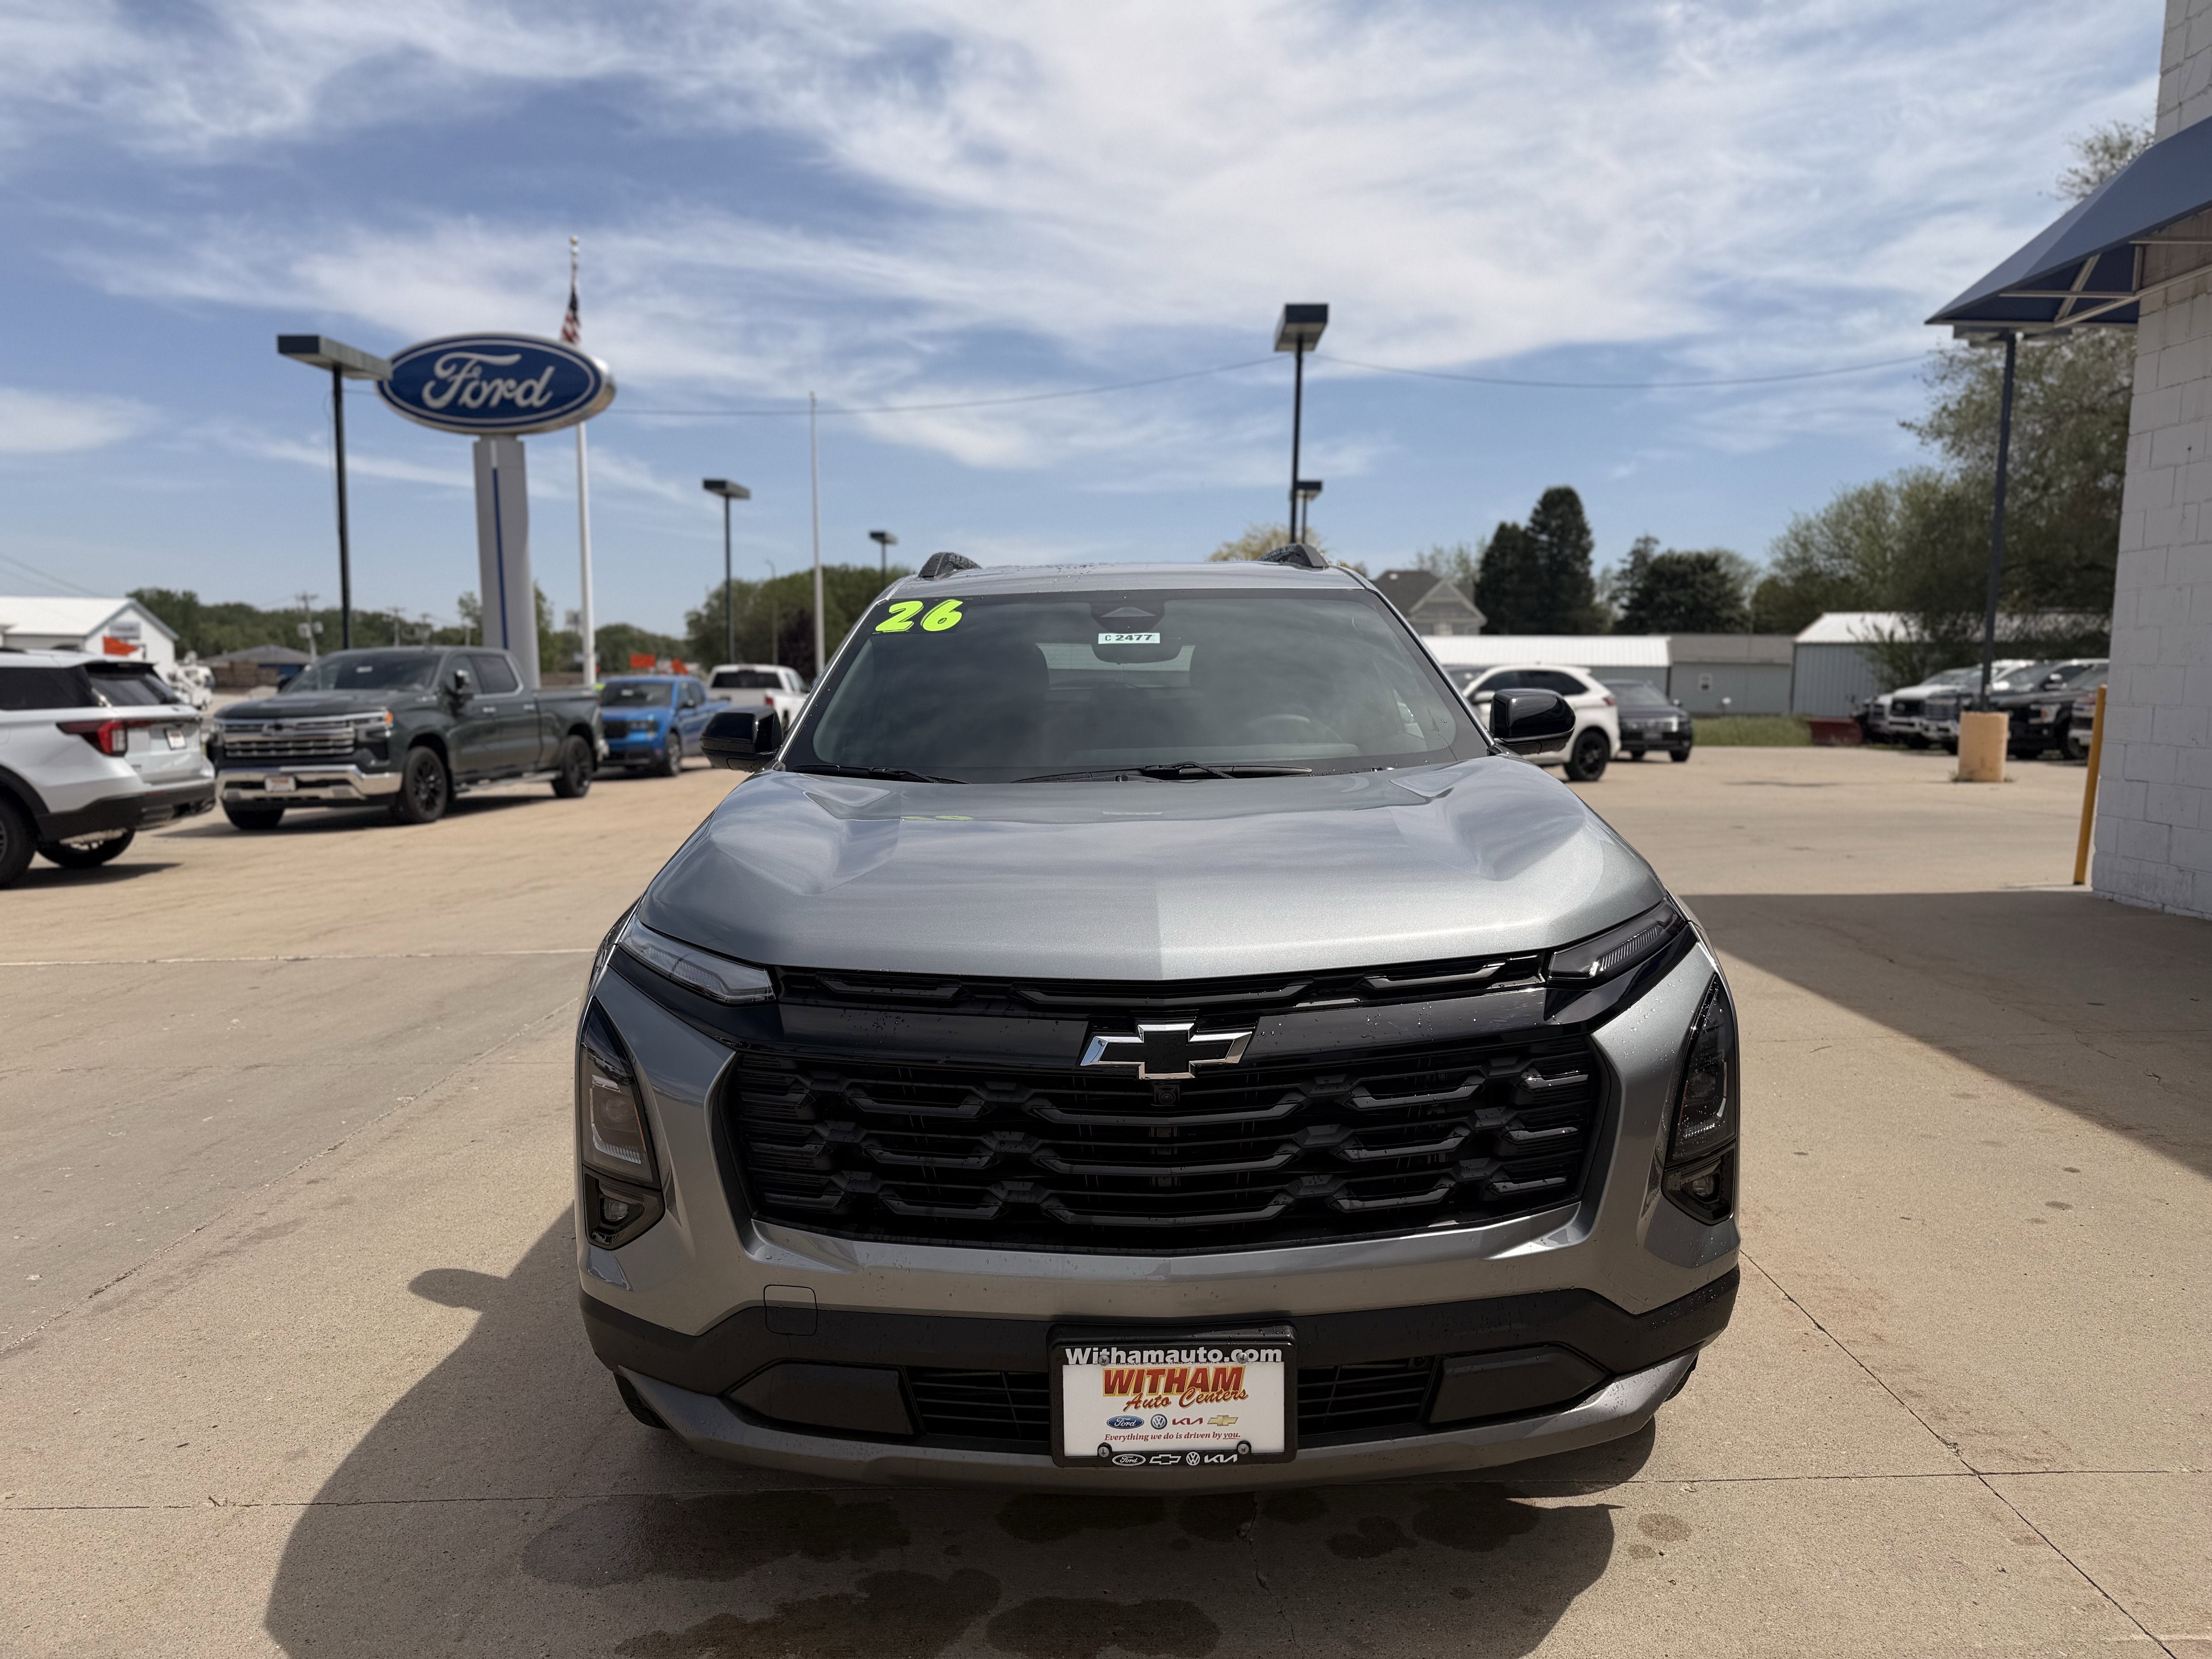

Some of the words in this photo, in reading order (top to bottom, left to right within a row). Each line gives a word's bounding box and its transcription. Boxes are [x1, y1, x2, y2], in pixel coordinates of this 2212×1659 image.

[422, 352, 555, 409] Ford
[875, 599, 963, 633] 26
[1065, 1346, 1282, 1365] Withamauto.com
[1103, 1365, 1245, 1396] WITHAM
[1123, 1392, 1172, 1412] Auto
[1178, 1387, 1249, 1409] Centers
[1104, 1433, 1149, 1442] Everything
[1212, 1432, 1222, 1440] by
[1204, 1454, 1238, 1463] KIA
